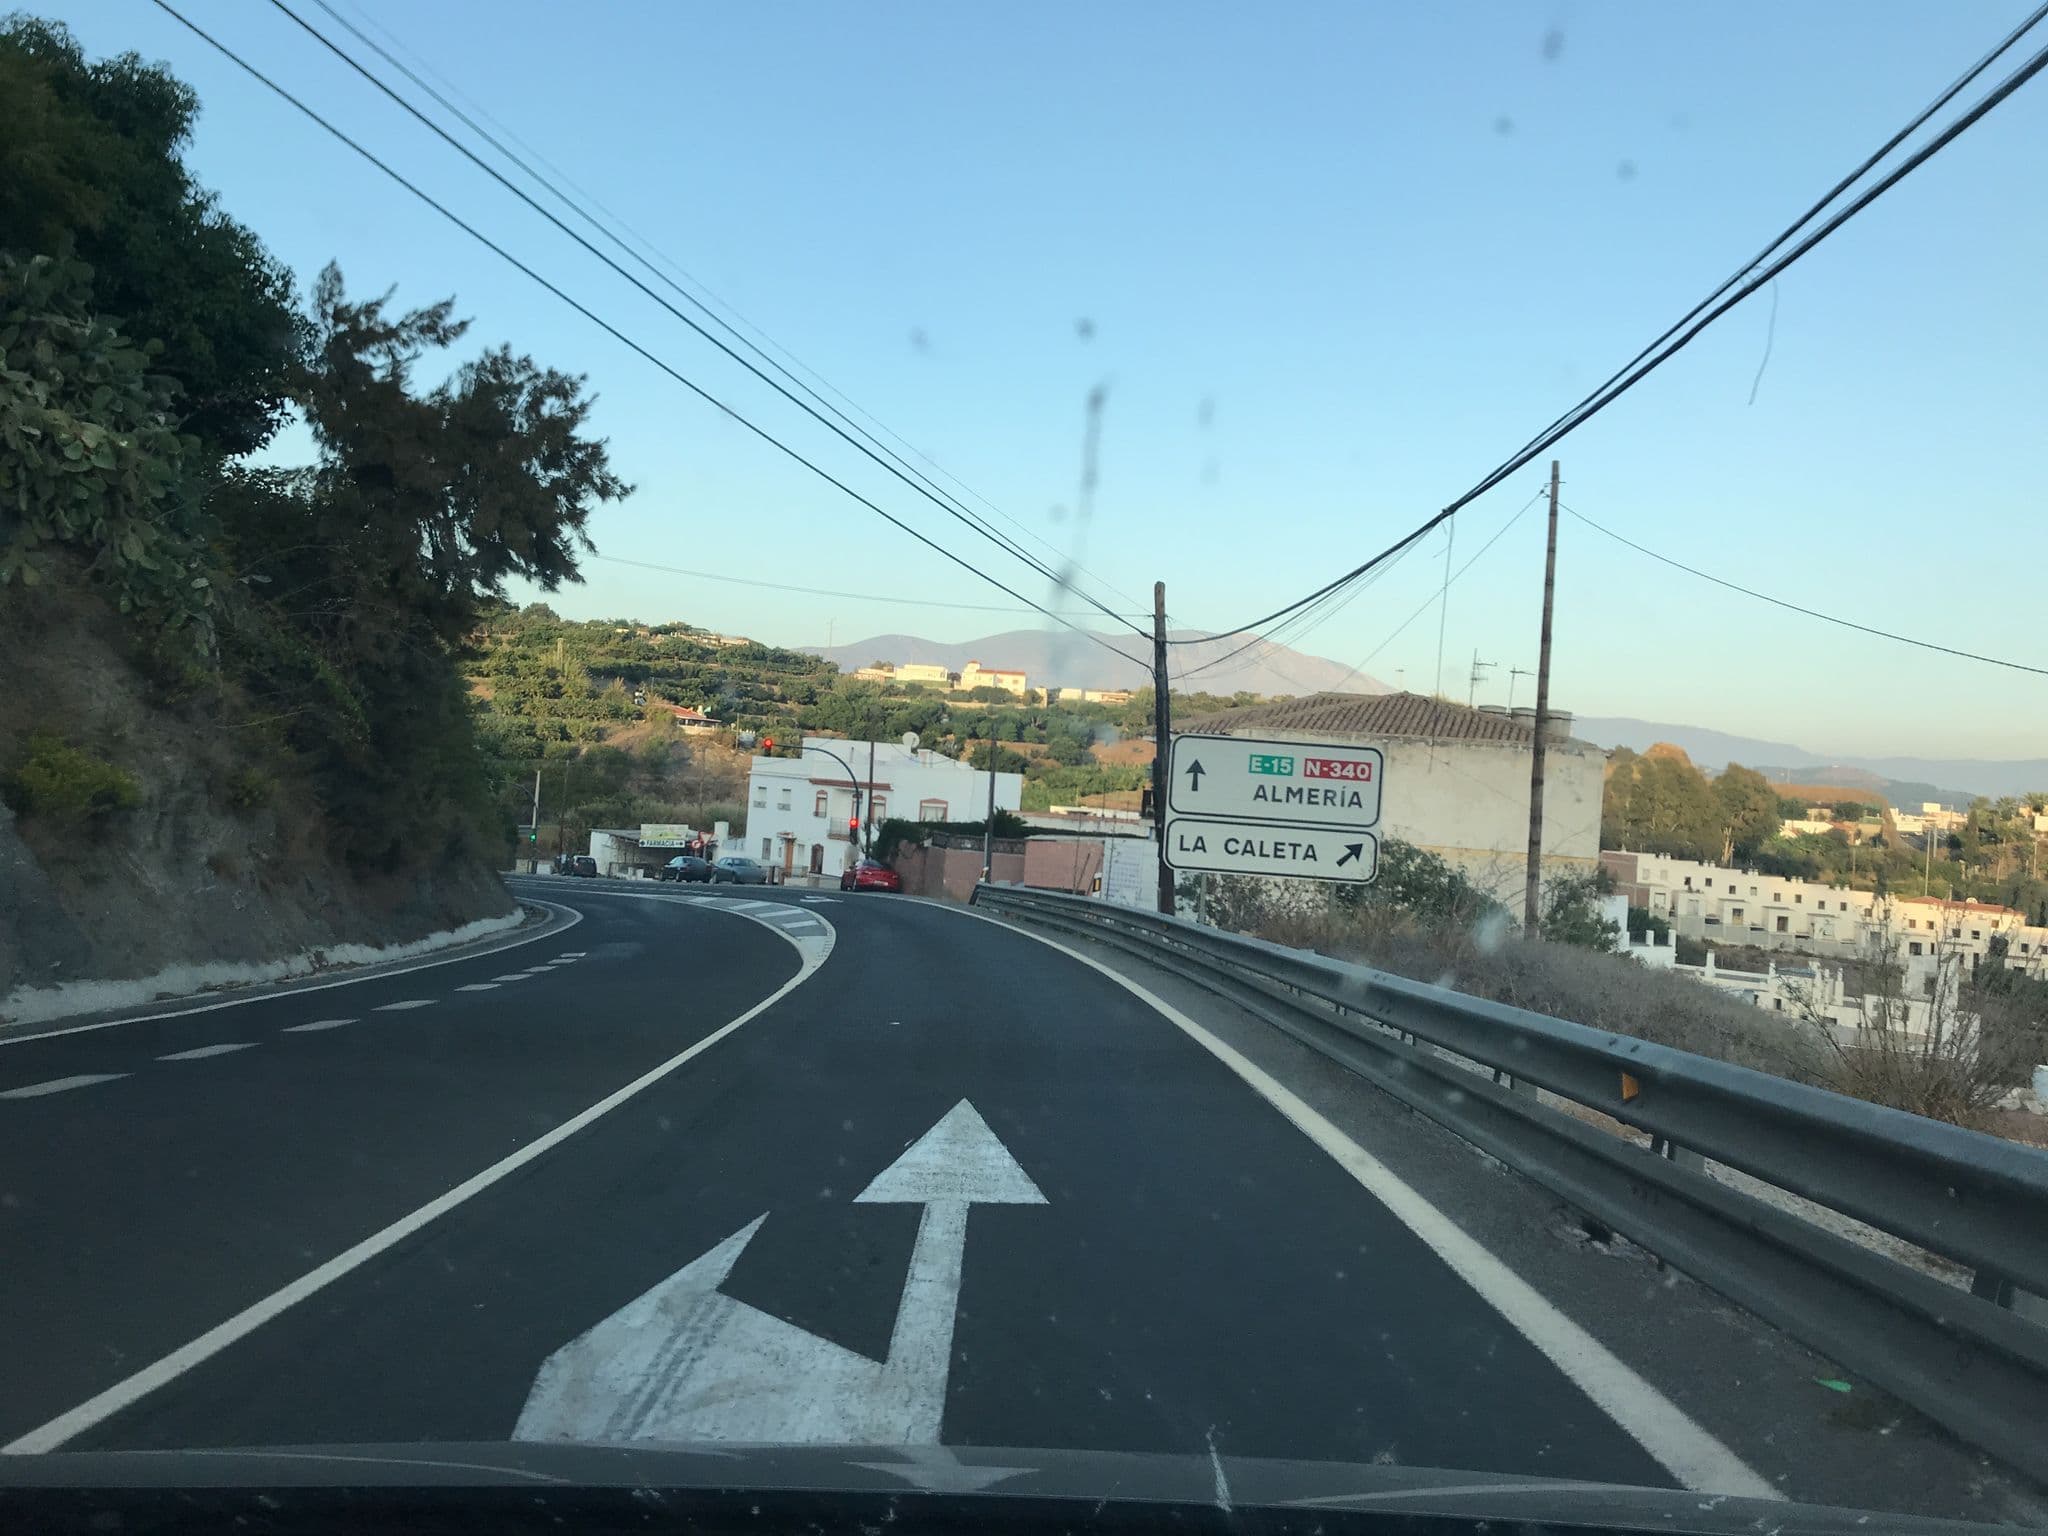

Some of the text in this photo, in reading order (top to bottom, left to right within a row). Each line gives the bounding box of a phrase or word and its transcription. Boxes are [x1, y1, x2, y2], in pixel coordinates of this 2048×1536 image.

[1251, 757, 1370, 779] E-15 N-340
[1253, 785, 1363, 809] ALMERÍA
[1179, 835, 1318, 861] LA CALETA
